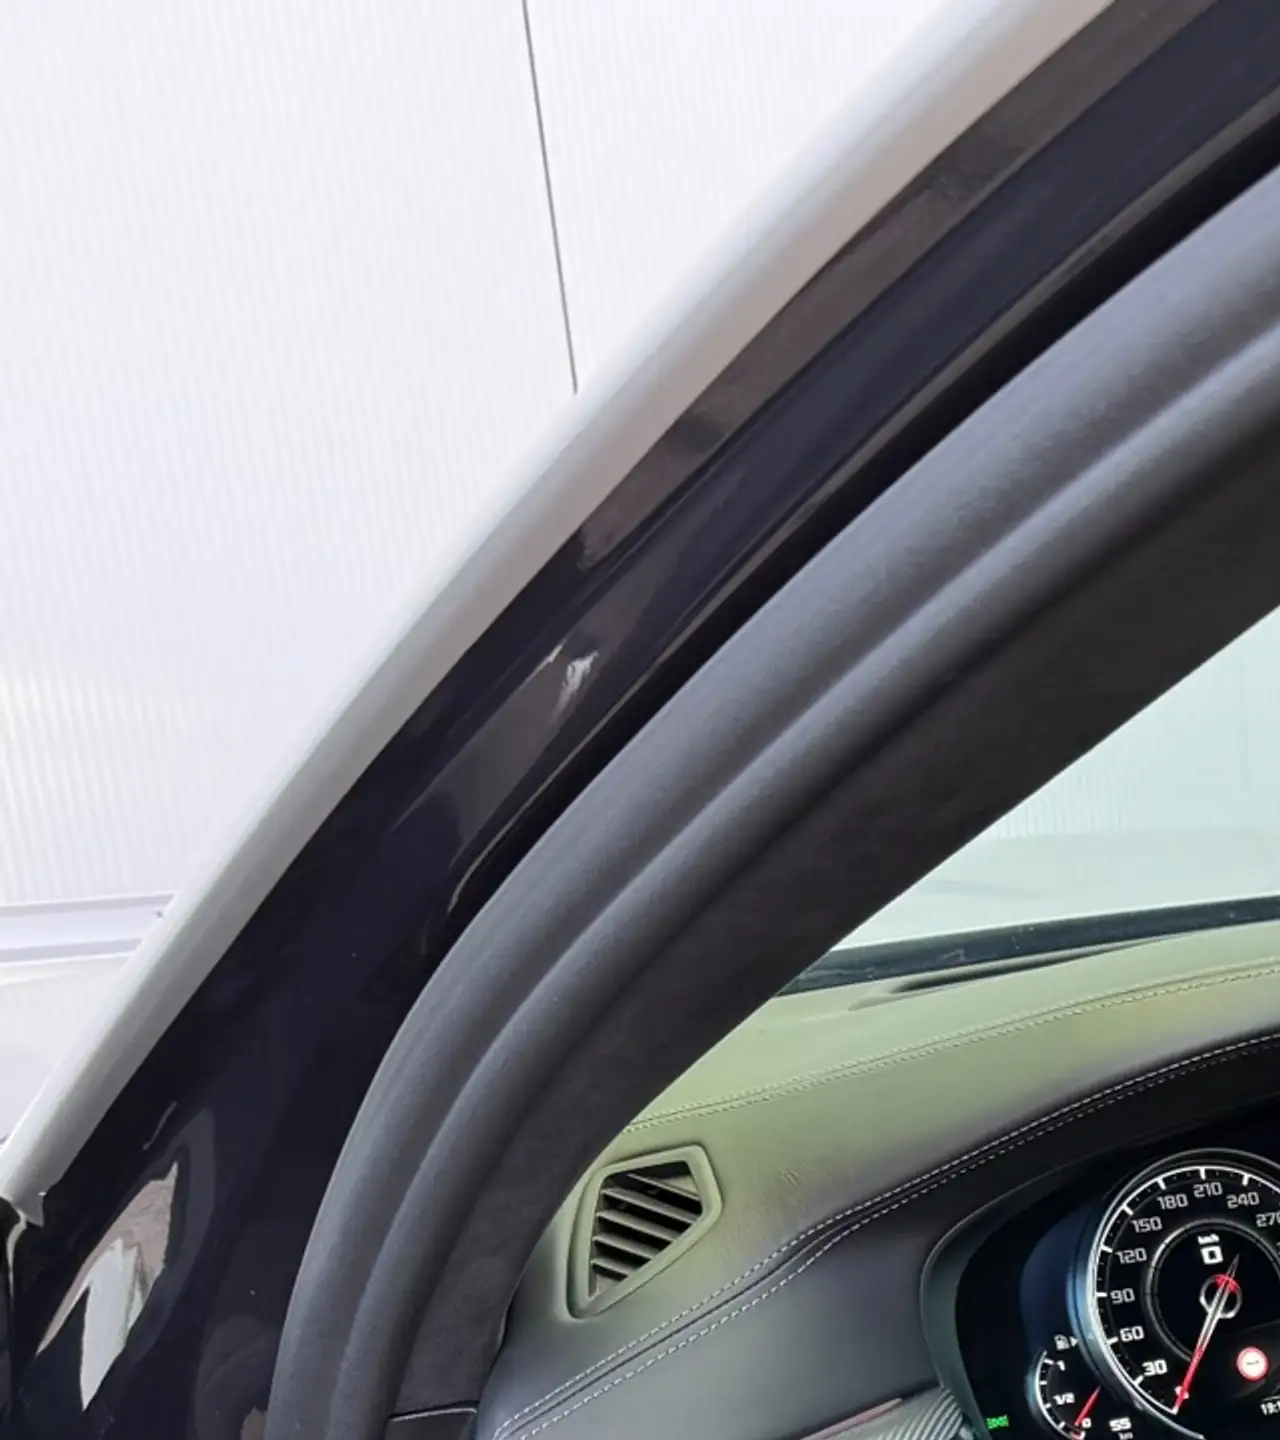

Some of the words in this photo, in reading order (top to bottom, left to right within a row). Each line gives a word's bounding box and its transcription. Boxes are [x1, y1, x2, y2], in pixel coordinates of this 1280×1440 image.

[1193, 1182, 1223, 1198] 210
[1156, 1194, 1188, 1210] 180
[1226, 1192, 1260, 1209] 240
[1131, 1216, 1163, 1233] 150
[1115, 1248, 1147, 1264] 120
[1110, 1288, 1135, 1304] 90
[1120, 1325, 1144, 1343] 60
[1142, 1359, 1168, 1376] 30
